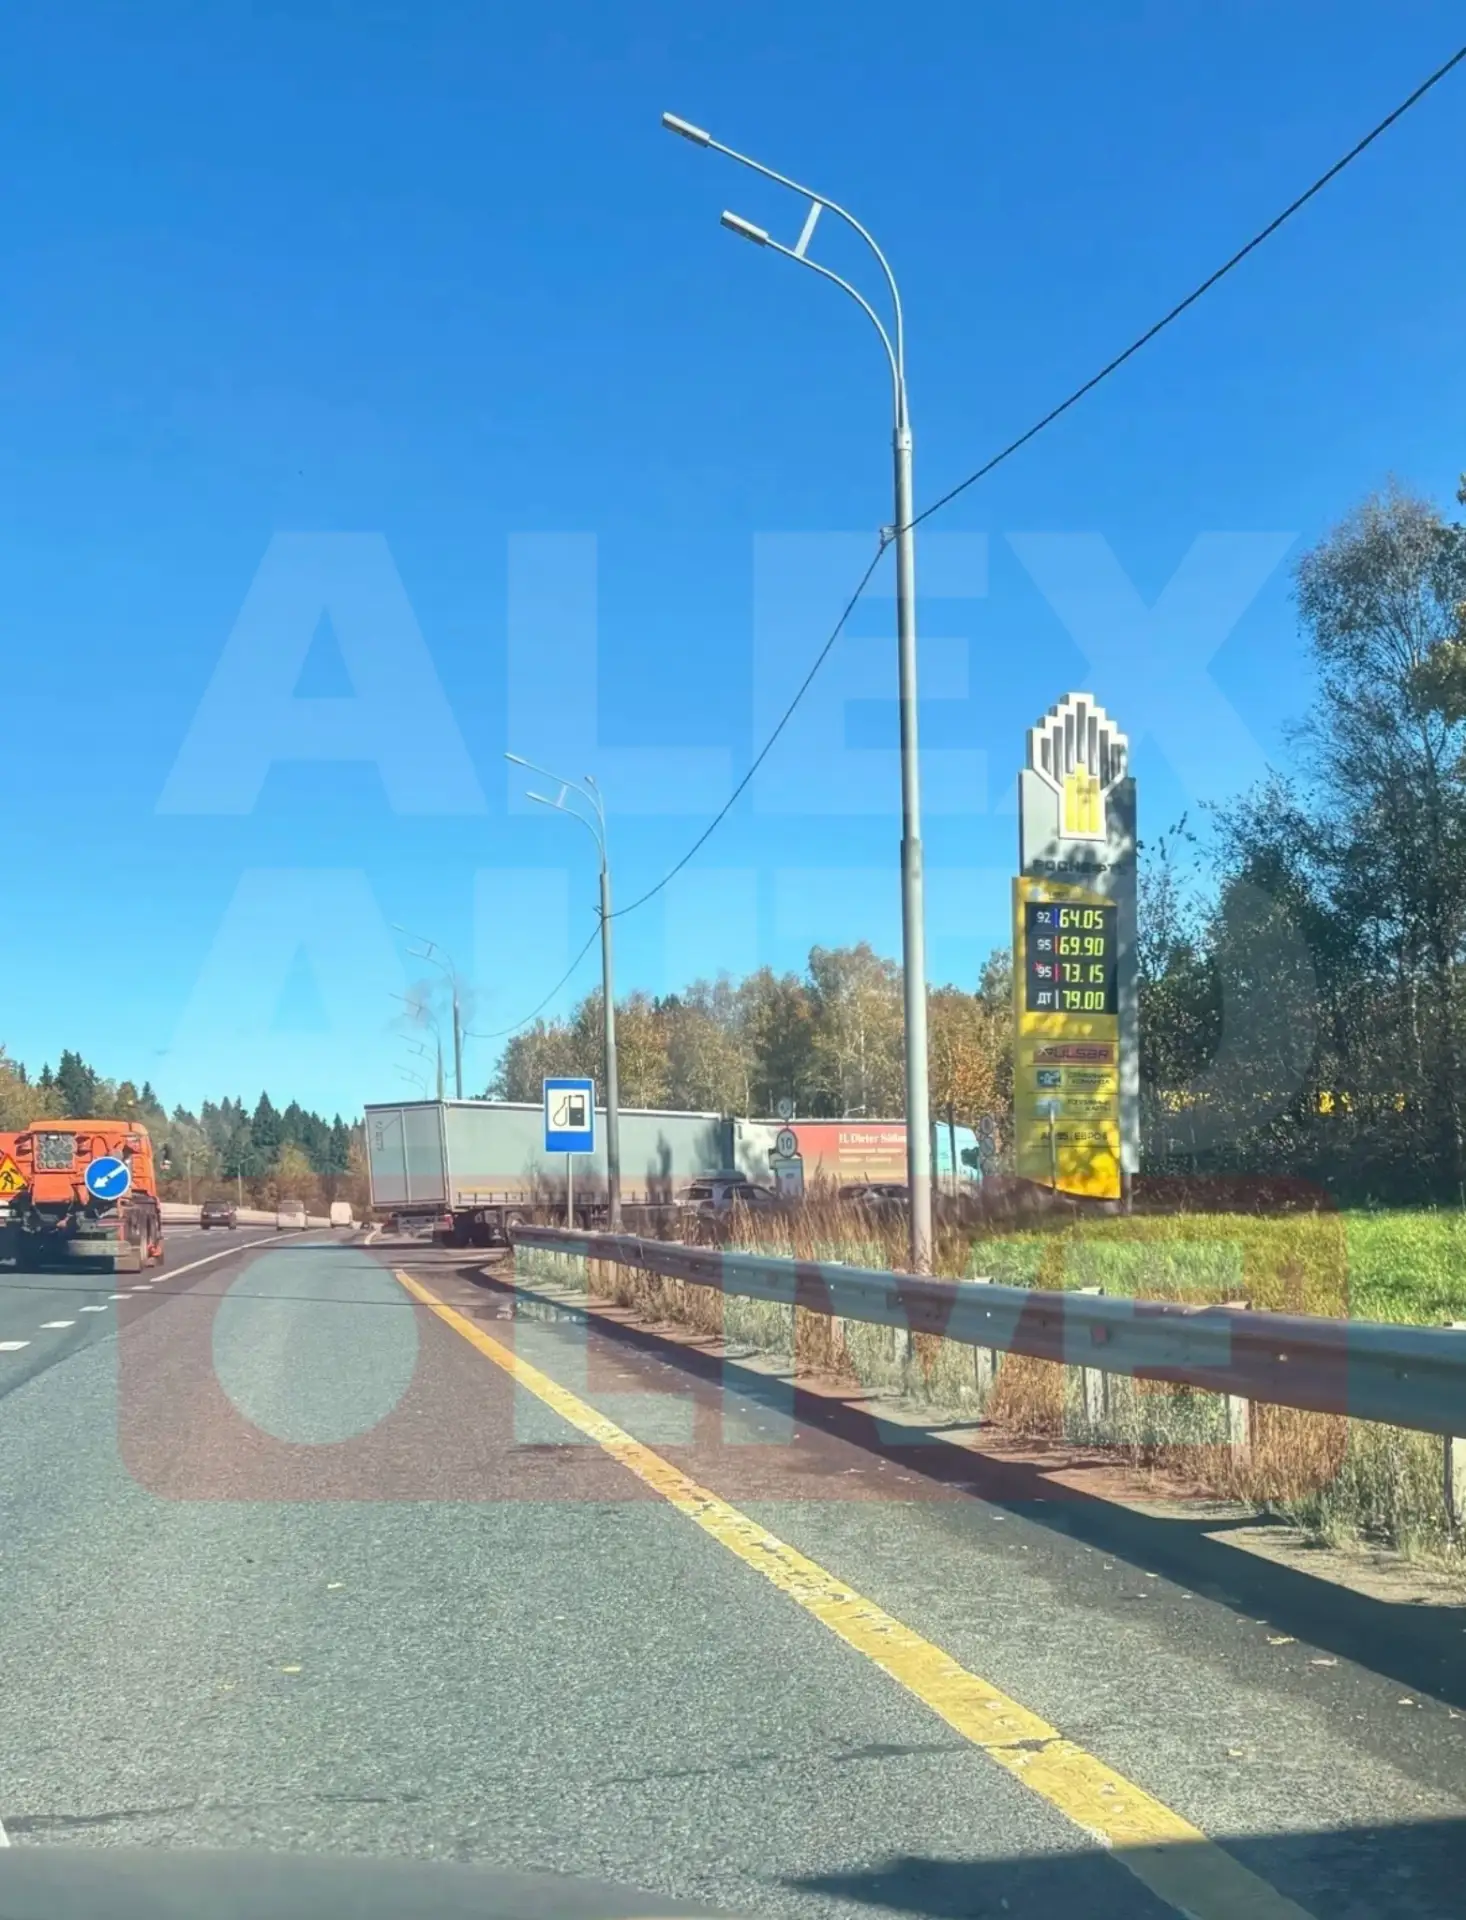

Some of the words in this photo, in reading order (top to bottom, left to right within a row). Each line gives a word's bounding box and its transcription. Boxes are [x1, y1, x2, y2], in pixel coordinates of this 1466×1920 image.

[1036, 911, 1051, 923] 92
[1059, 909, 1104, 929] 64.05
[1036, 939, 1052, 951] 95
[1059, 936, 1105, 956] 69.90
[1036, 992, 1052, 1005] ДТ
[1062, 990, 1105, 1010] 79.00
[781, 1137, 793, 1150] 10
